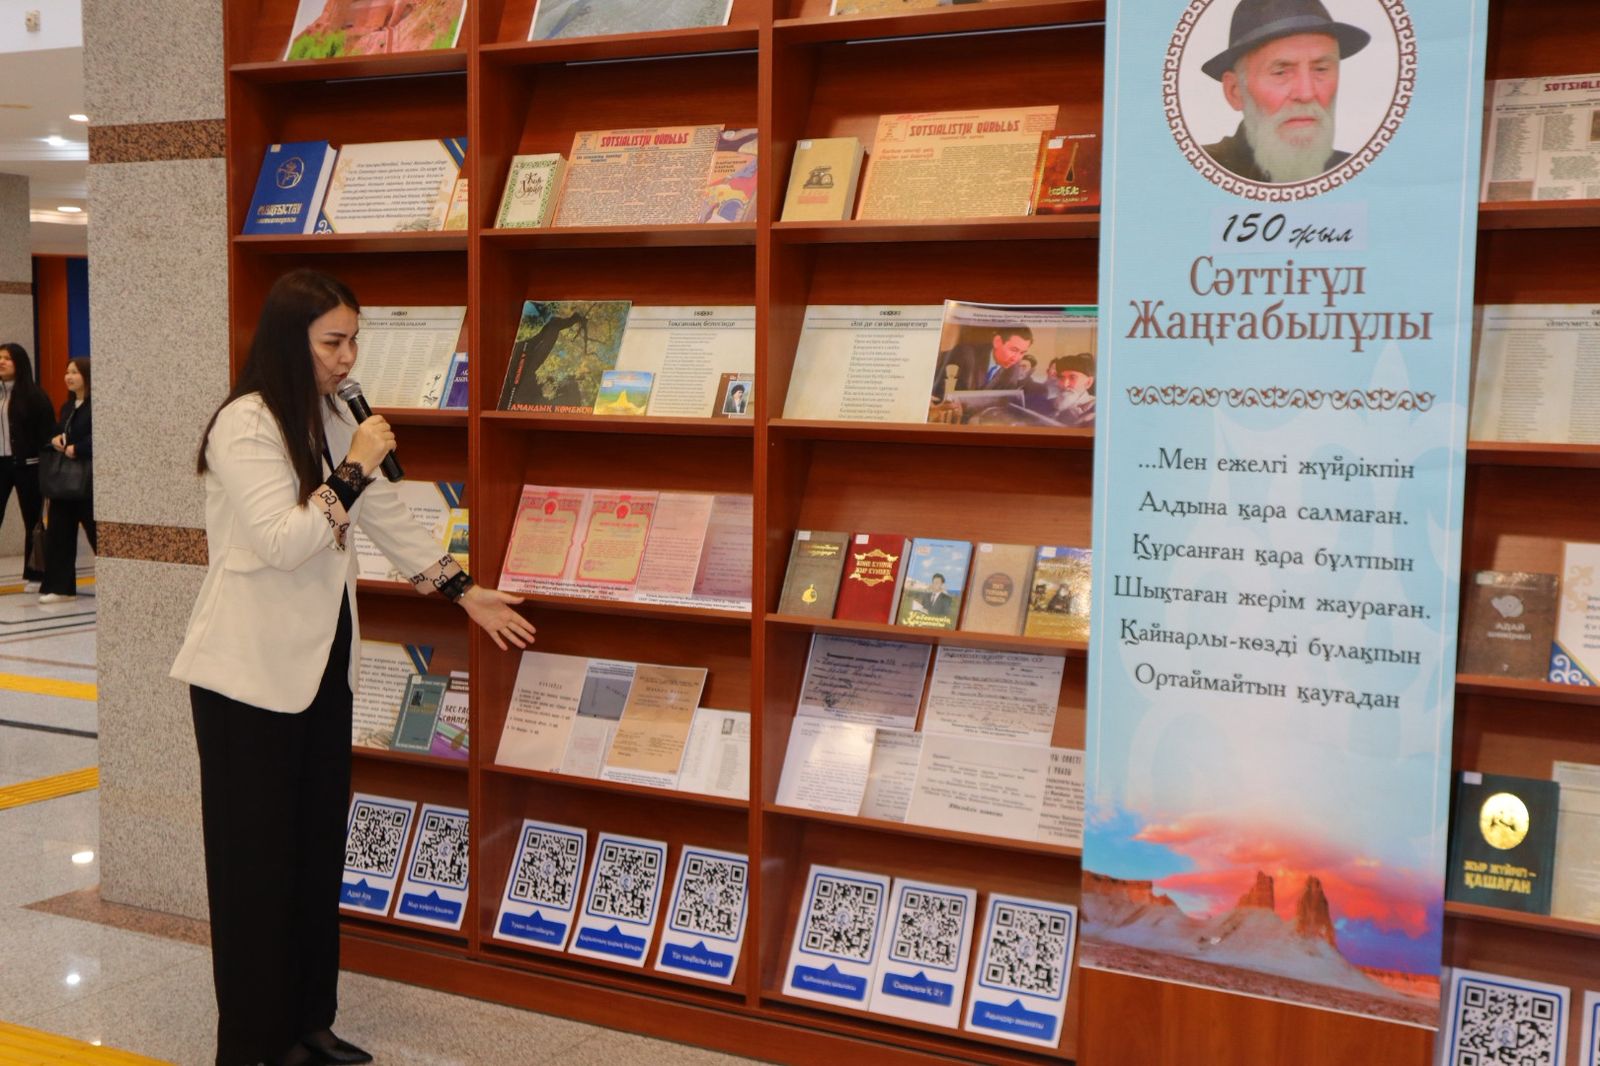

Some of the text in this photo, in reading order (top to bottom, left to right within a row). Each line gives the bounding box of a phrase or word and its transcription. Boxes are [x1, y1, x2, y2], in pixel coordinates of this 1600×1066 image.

[1222, 213, 1354, 248] 150 жыл
[1190, 255, 1367, 307] Сәттіғұл
[1125, 300, 1434, 352] Жаңғабылұлы
[1138, 447, 1415, 481] ...Мен ежелгі жүйрікпін
[1138, 491, 1409, 526] Алдына қара салмаған.
[1132, 533, 1415, 573] Құрсанған қара бұлтпын
[1113, 575, 1431, 621] Шықтаған жерім жаураған.
[1120, 618, 1421, 666] Қайнарлы-көзді бұлақпын
[1135, 663, 1400, 710] Ортаймайтын қауғадан
[1464, 872, 1532, 894] ҚАШАҒАН
